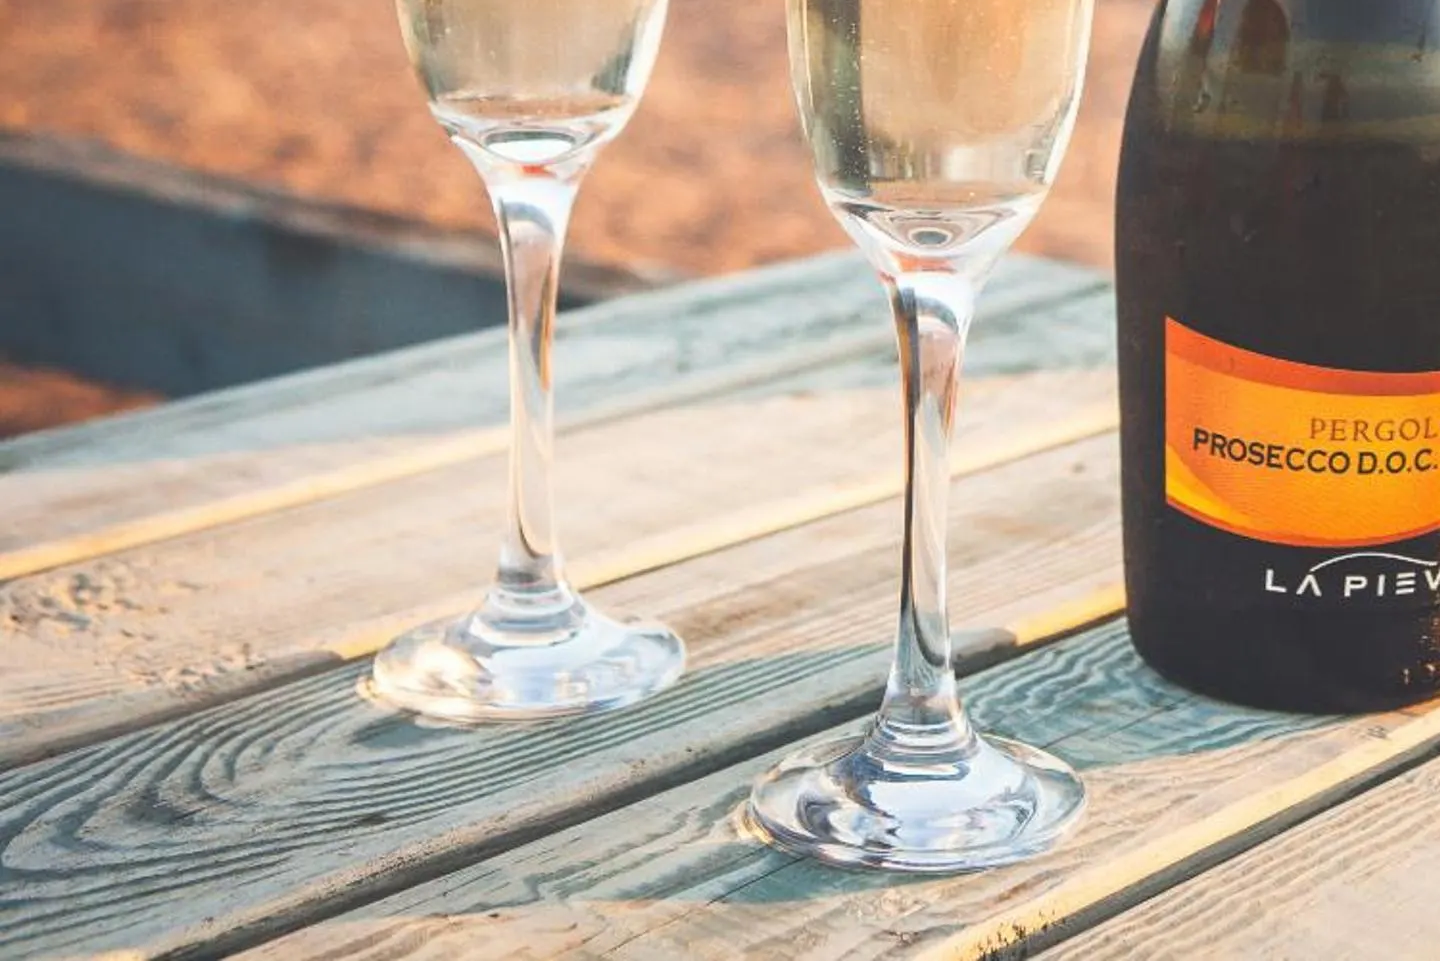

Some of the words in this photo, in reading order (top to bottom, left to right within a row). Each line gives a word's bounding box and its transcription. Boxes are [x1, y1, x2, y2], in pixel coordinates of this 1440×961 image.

[1192, 427, 1350, 475] PROSECCO
[1356, 448, 1439, 474] D.O.C.
[1264, 569, 1322, 597] LA
